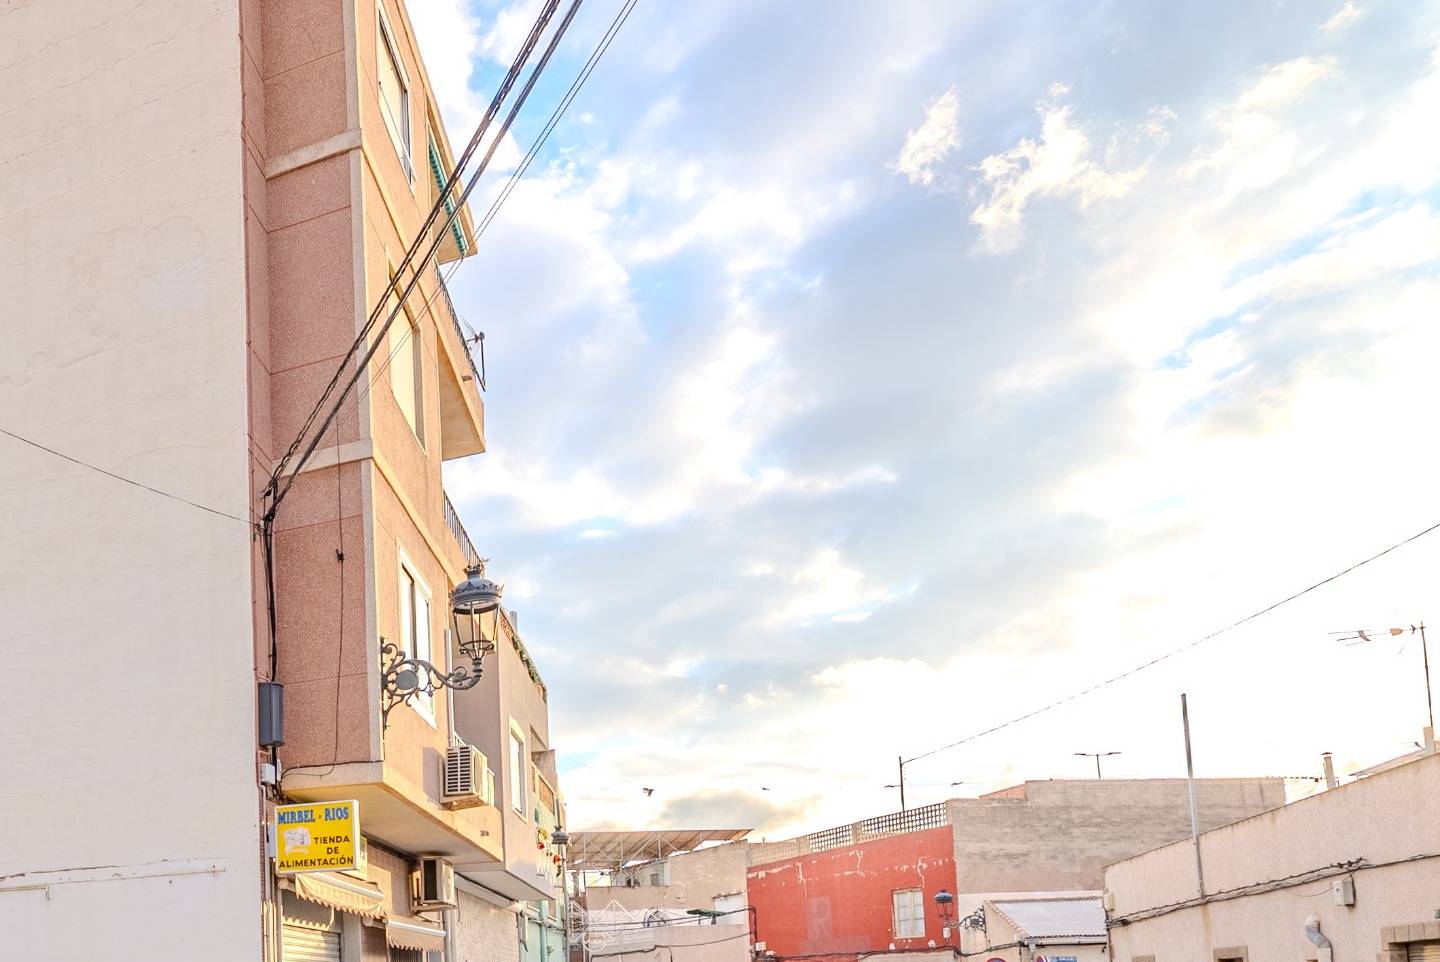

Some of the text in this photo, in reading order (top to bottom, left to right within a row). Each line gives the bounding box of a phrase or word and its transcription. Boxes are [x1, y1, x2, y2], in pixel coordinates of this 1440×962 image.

[277, 809, 315, 824] MIRBEL
[324, 807, 349, 821] RIOS
[313, 835, 350, 845] TIENDA
[326, 847, 339, 855] DE
[278, 855, 354, 868] ALIMENTACIÓN
